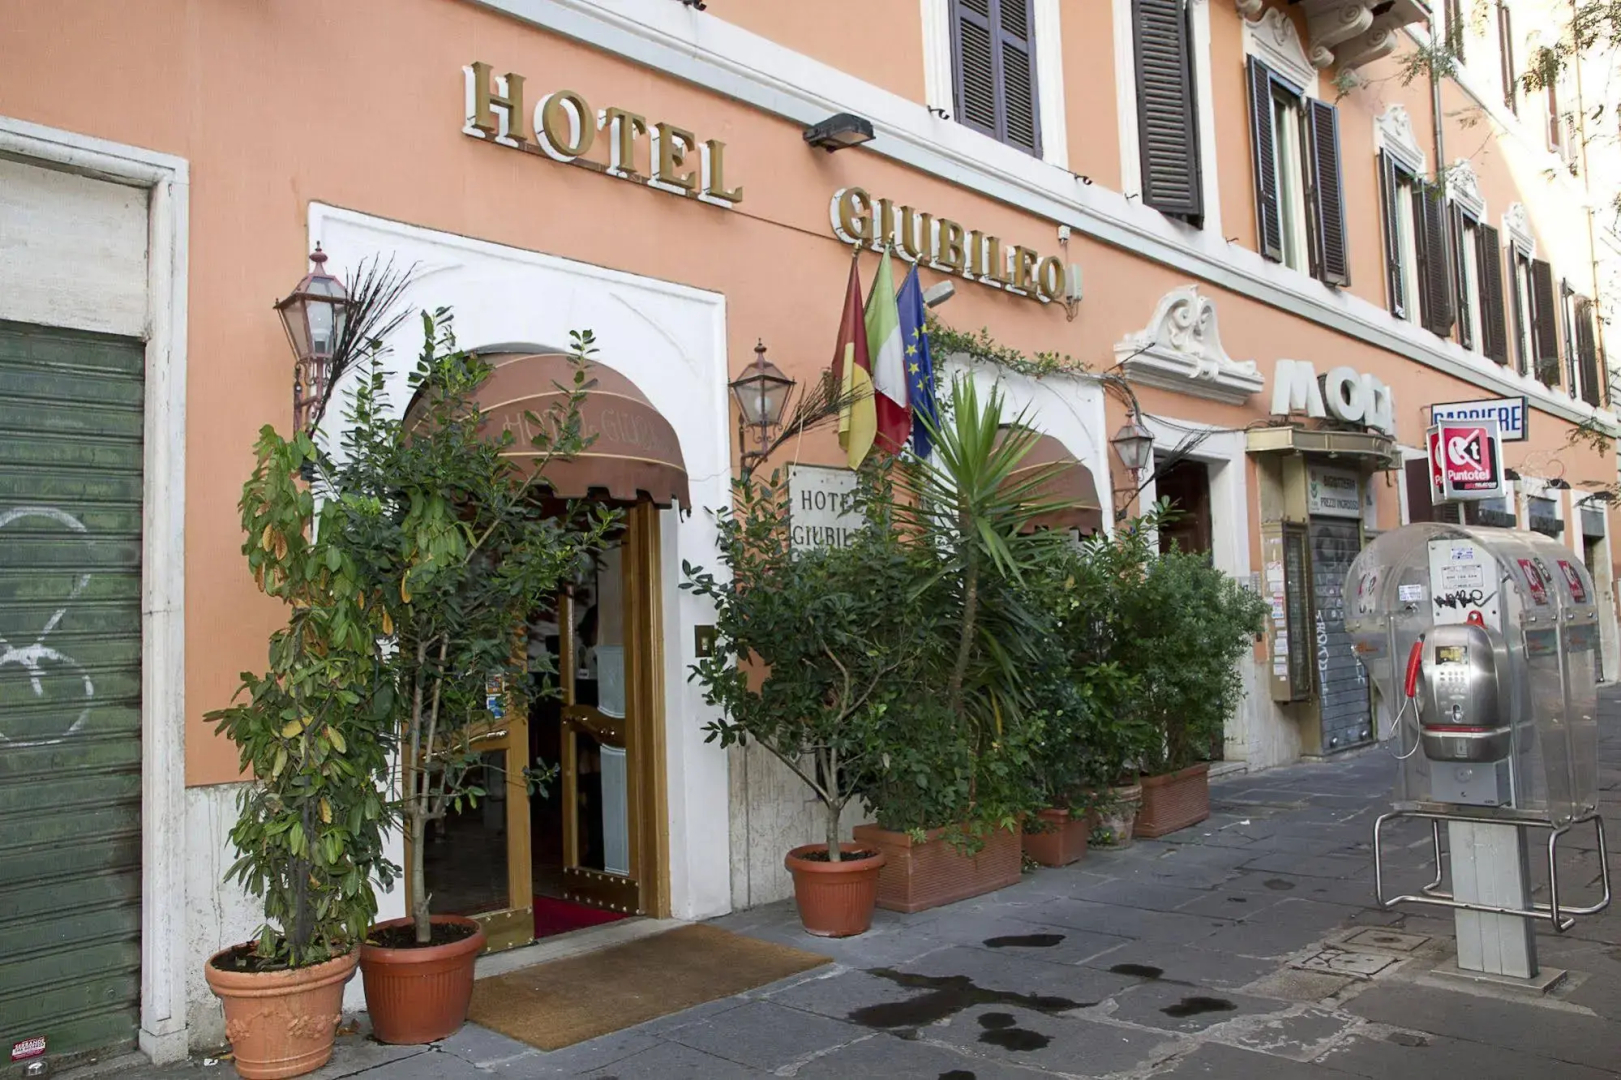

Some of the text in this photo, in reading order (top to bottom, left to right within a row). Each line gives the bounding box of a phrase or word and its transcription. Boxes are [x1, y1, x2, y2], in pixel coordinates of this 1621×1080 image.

[463, 61, 743, 208] HOTEL
[830, 187, 1066, 304] GIUBILEO
[1447, 469, 1490, 480] Puntotel
